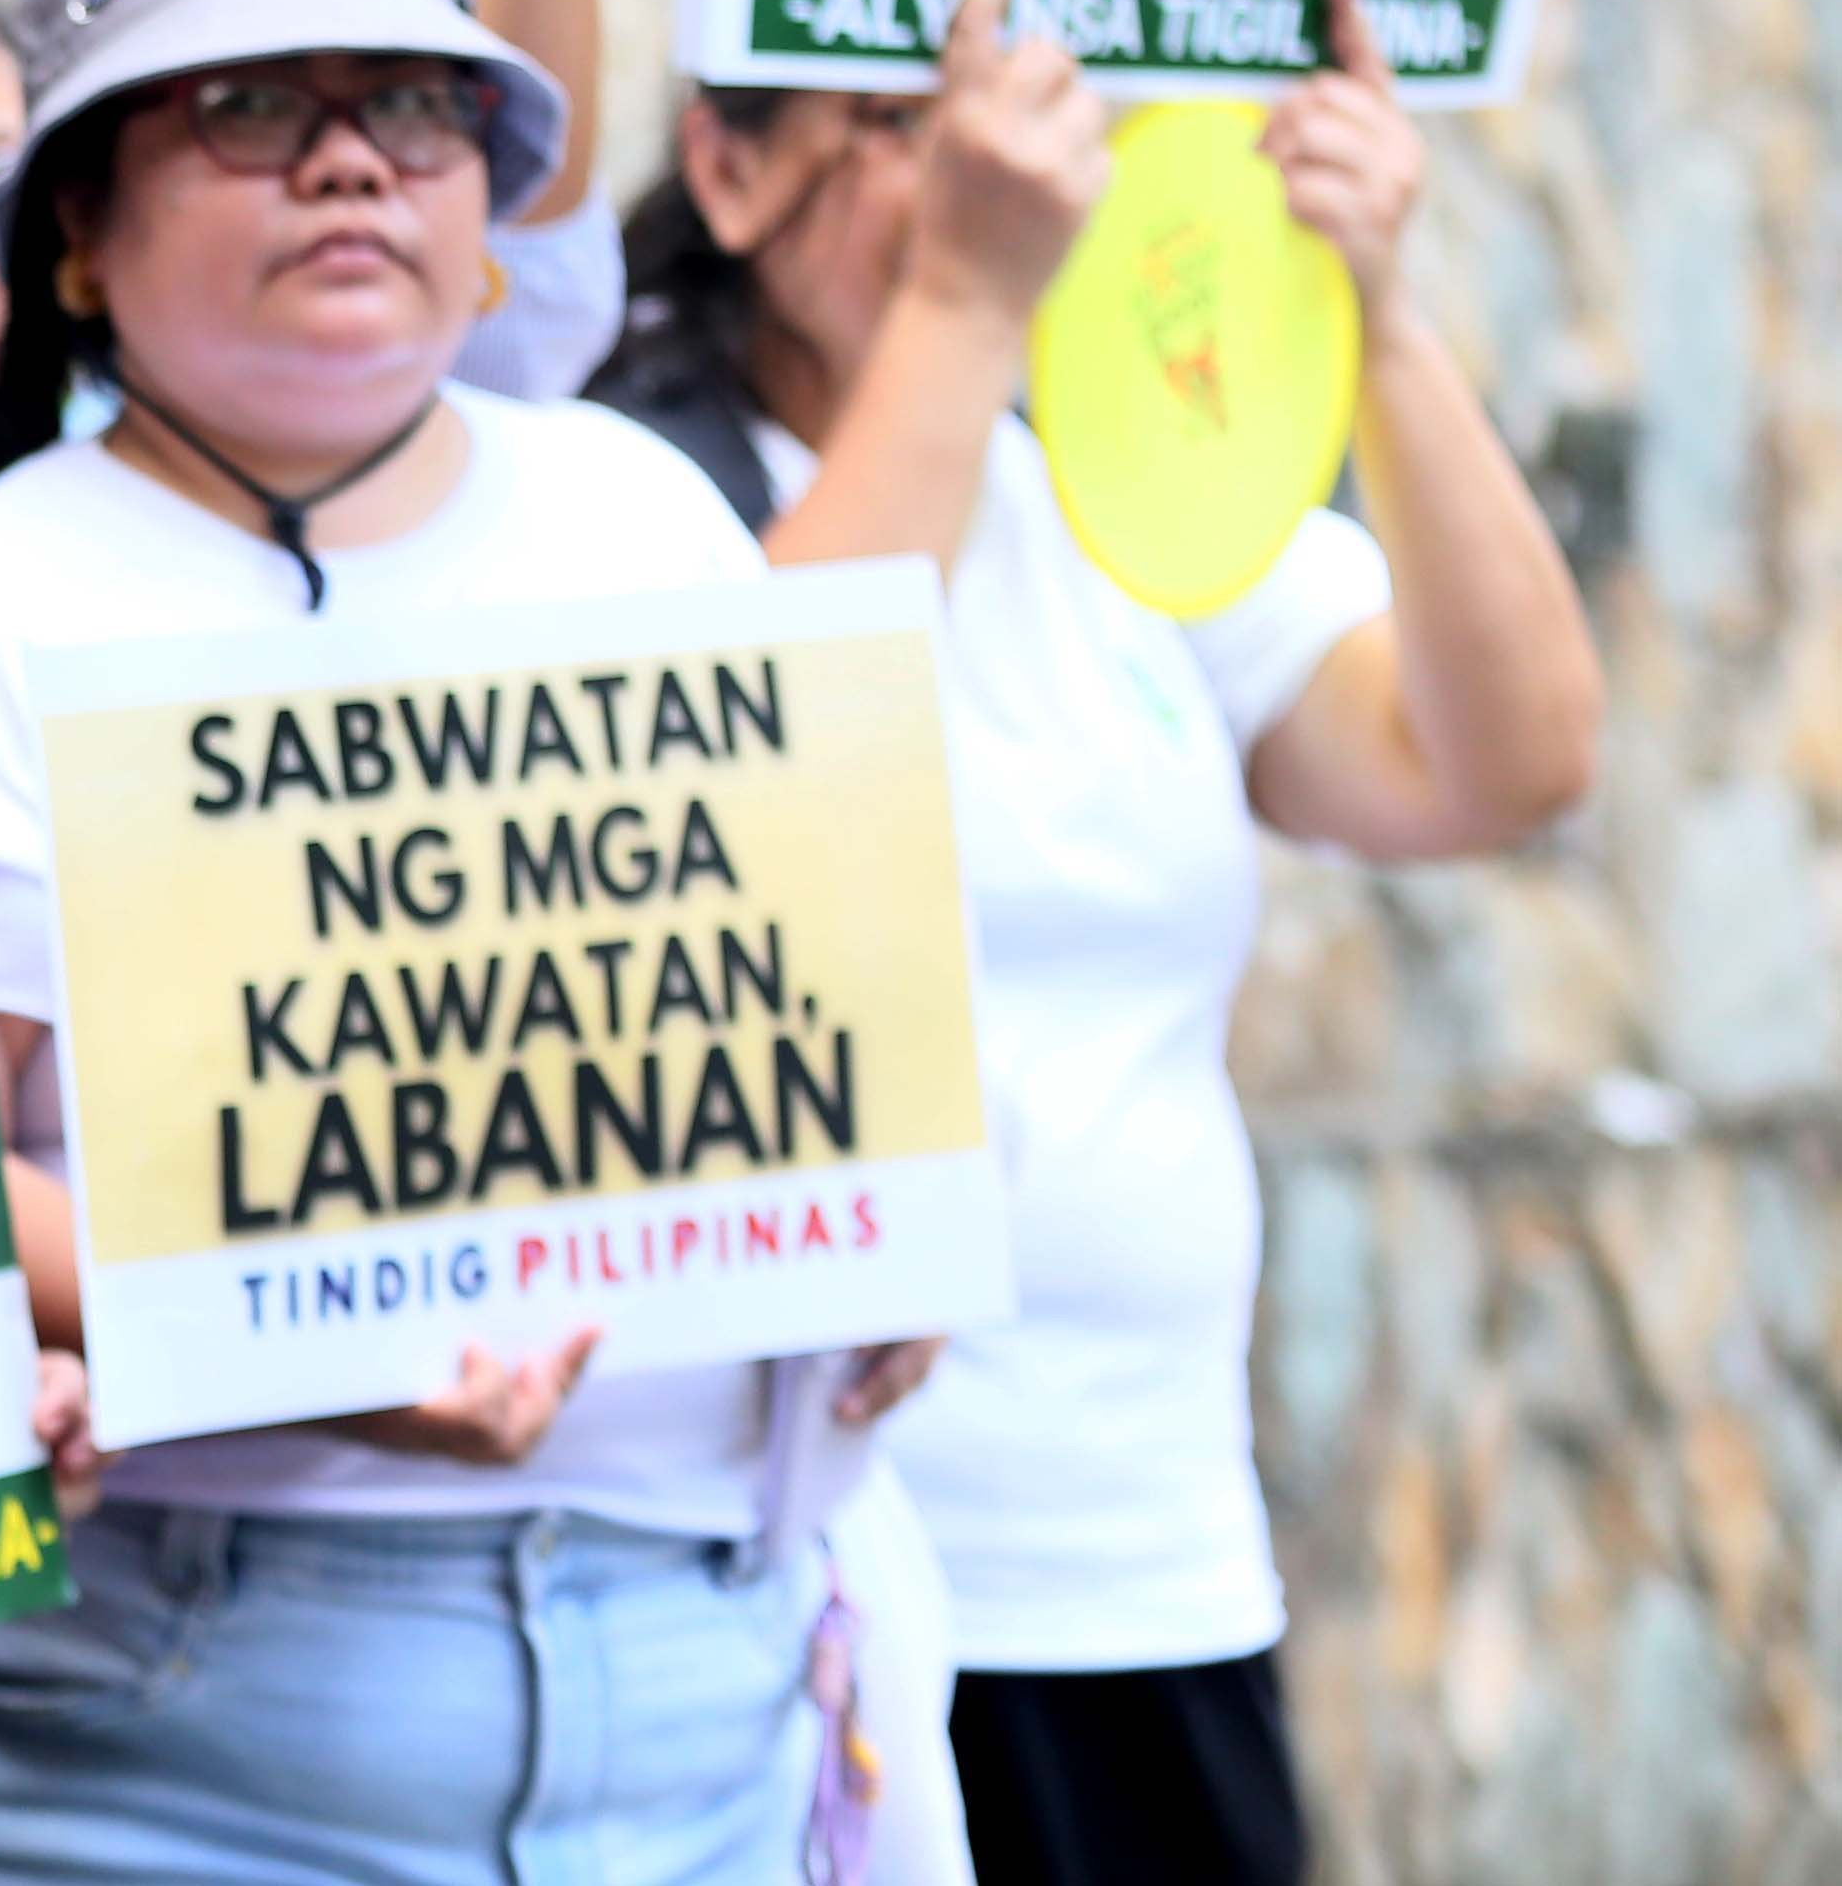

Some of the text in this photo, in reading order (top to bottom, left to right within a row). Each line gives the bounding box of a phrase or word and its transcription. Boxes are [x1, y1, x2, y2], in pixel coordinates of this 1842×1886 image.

[188, 656, 788, 818] SABWATAN
[305, 799, 740, 938] NG MGA
[241, 922, 818, 1082] KAWATAN,
[218, 1029, 858, 1236] LABANAN
[243, 1194, 882, 1333] TINDIG PILIPINAS
